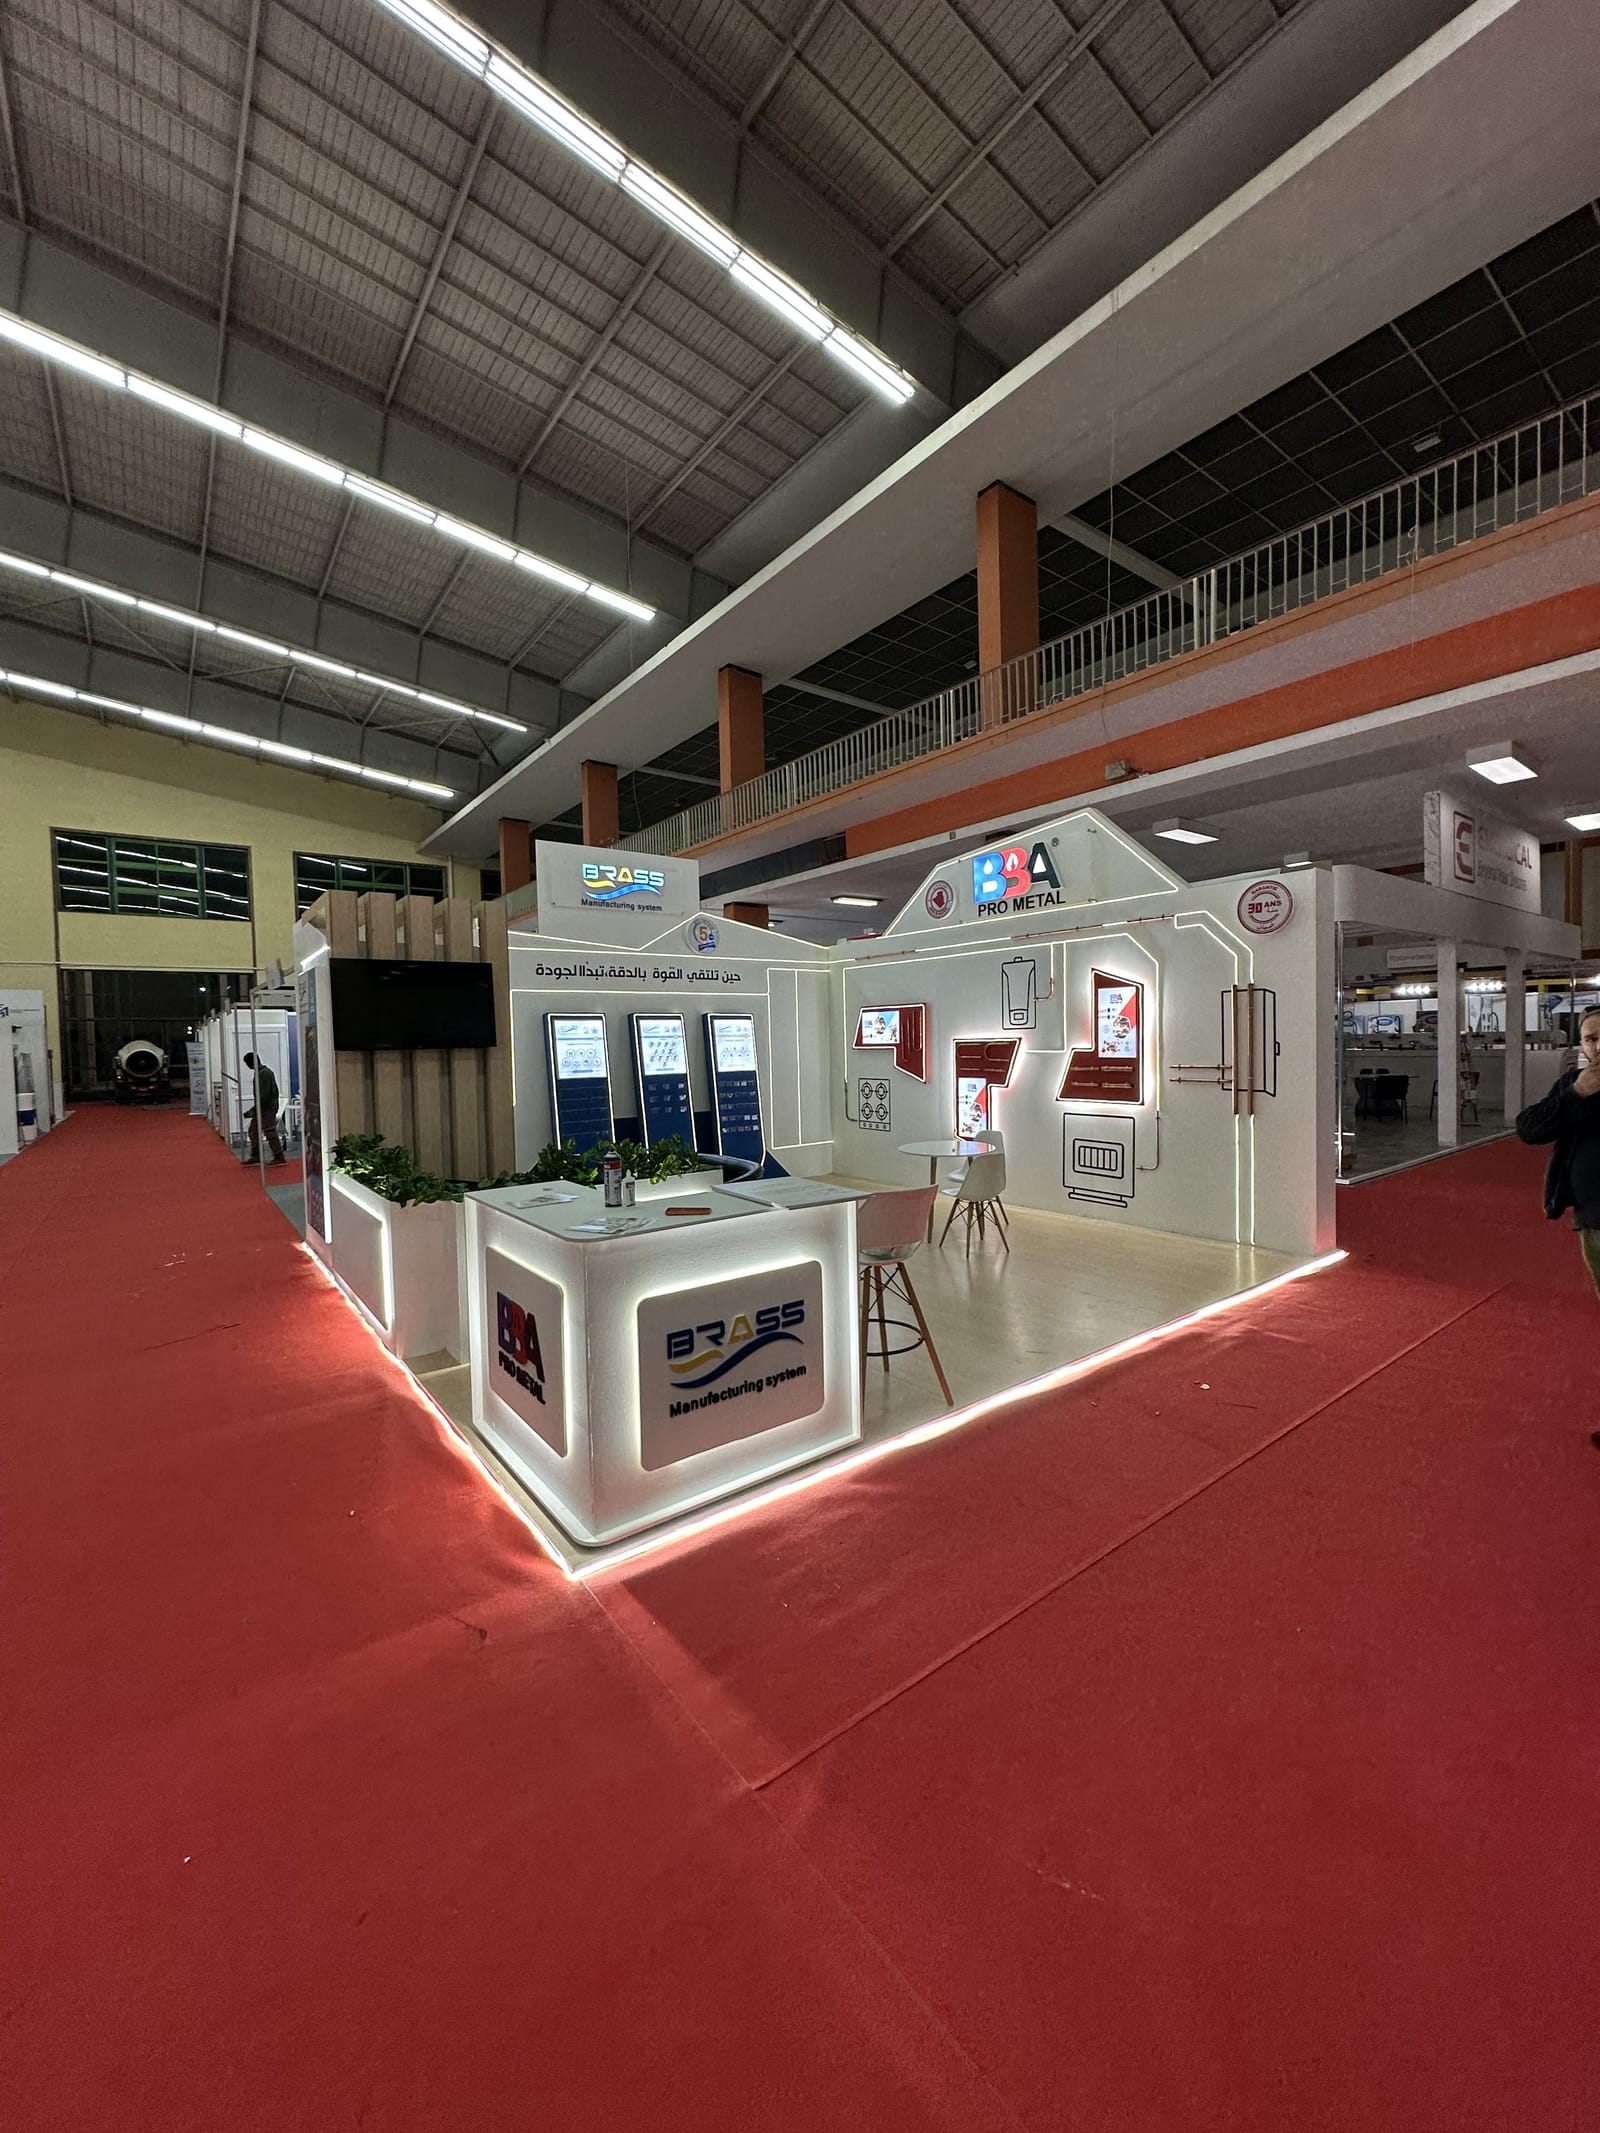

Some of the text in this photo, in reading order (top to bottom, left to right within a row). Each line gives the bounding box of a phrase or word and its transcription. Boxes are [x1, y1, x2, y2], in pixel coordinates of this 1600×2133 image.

[582, 863, 664, 887] BRASS
[973, 842, 1061, 905] BBA
[581, 898, 662, 912] Manufacturing system
[978, 891, 1066, 917] PRO METAL
[1248, 900, 1282, 914] 30 ANS
[699, 926, 708, 941] 5
[653, 966, 682, 983] القوة
[687, 969, 719, 983] تلتقي
[722, 971, 741, 984] حين
[667, 1300, 805, 1360] BRASS
[499, 1350, 545, 1405] PRO METAL
[670, 1365, 807, 1417] Manufacturing system
